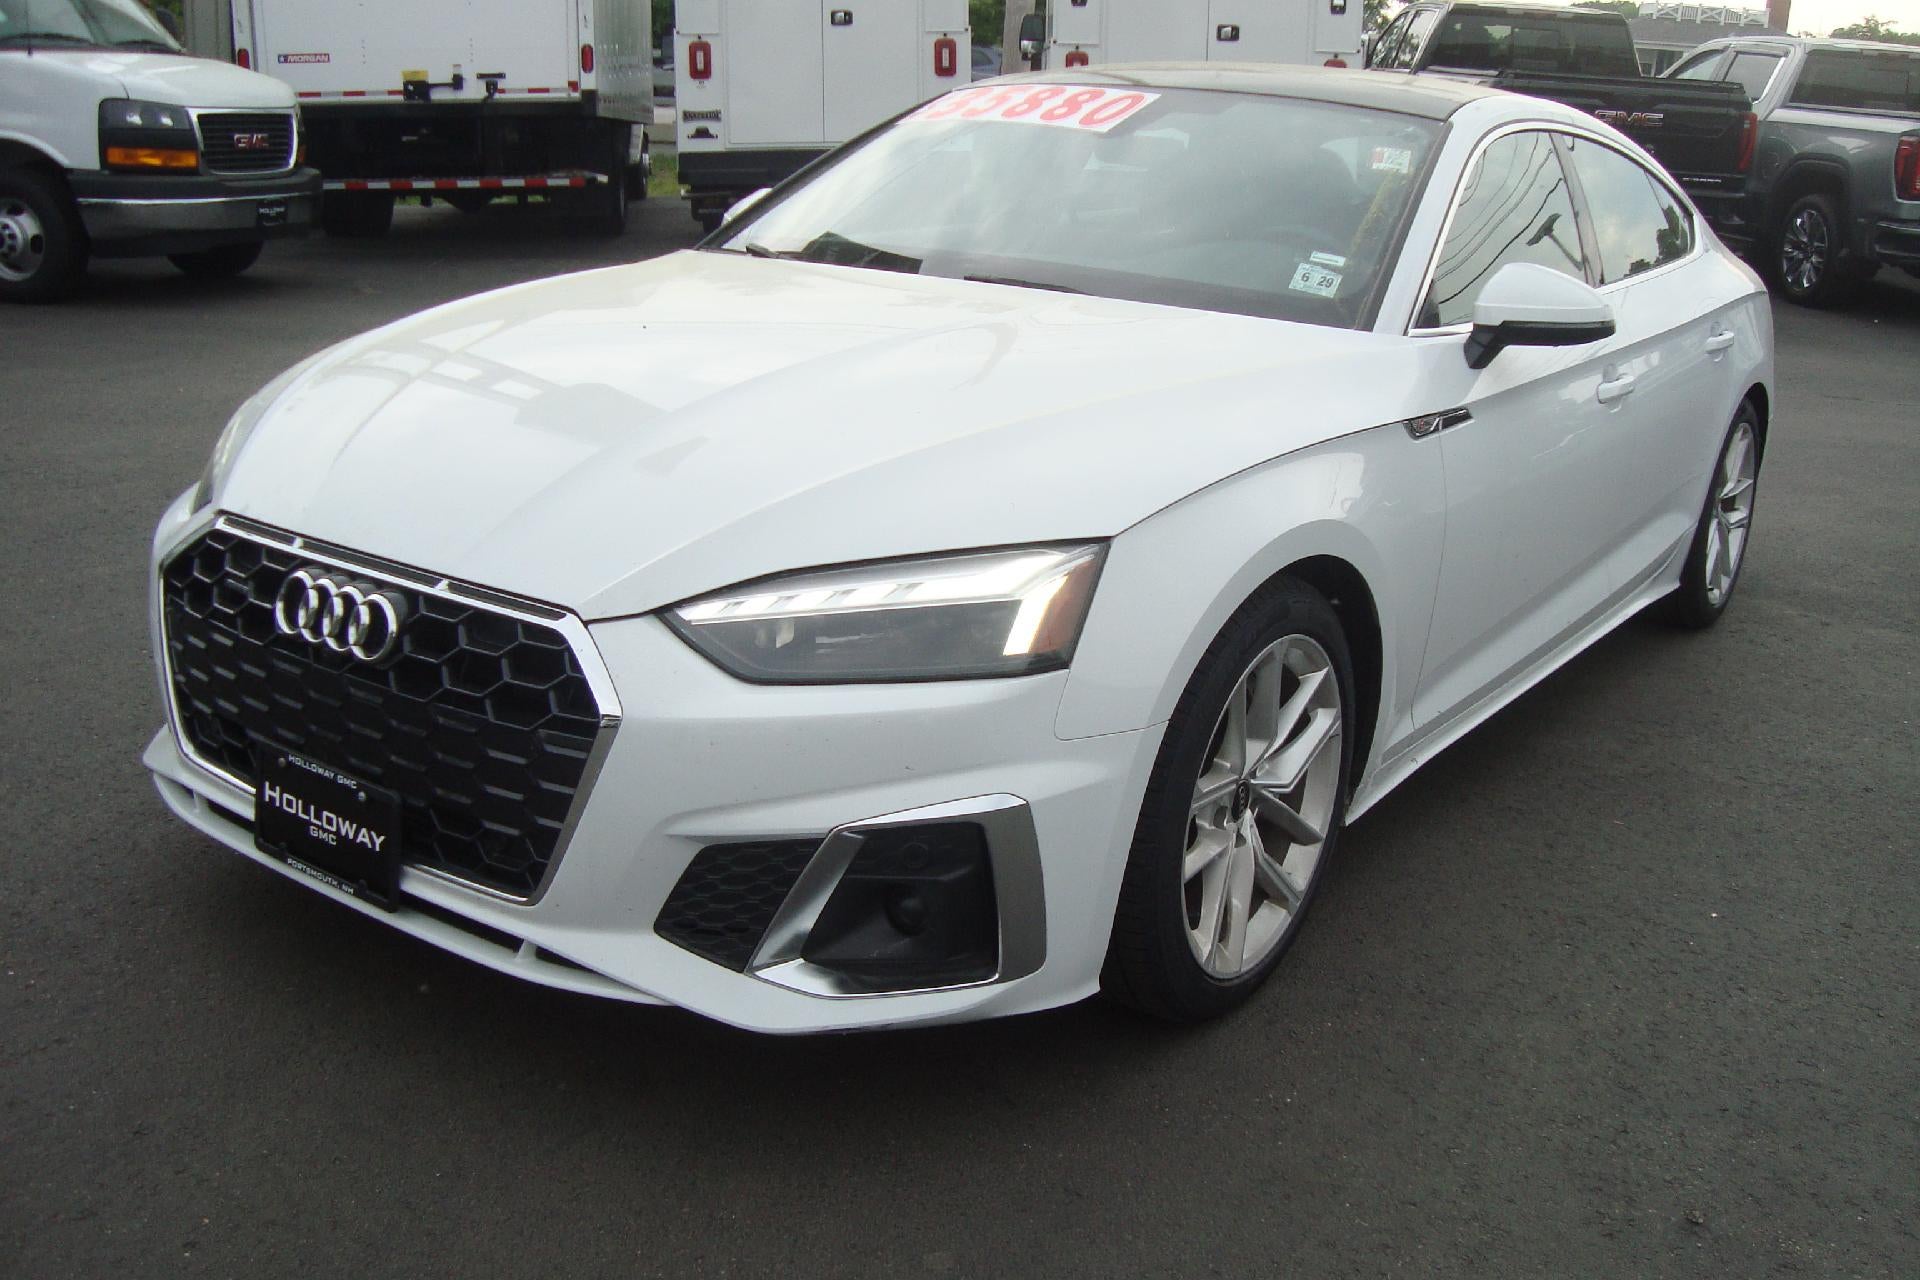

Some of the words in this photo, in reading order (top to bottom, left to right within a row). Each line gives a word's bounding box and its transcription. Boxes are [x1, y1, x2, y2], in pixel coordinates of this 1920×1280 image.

[287, 54, 329, 63] MORGAN
[1595, 110, 1664, 126] GMC
[234, 134, 269, 147] GMC
[1301, 272, 1310, 282] 6
[1316, 275, 1335, 288] 29
[288, 754, 335, 780] HOLLOWAY
[337, 775, 357, 789] GMC
[264, 780, 386, 852] HOLLOWAY
[309, 826, 337, 846] GMC
[287, 857, 340, 889] PORTSMOUTH,
